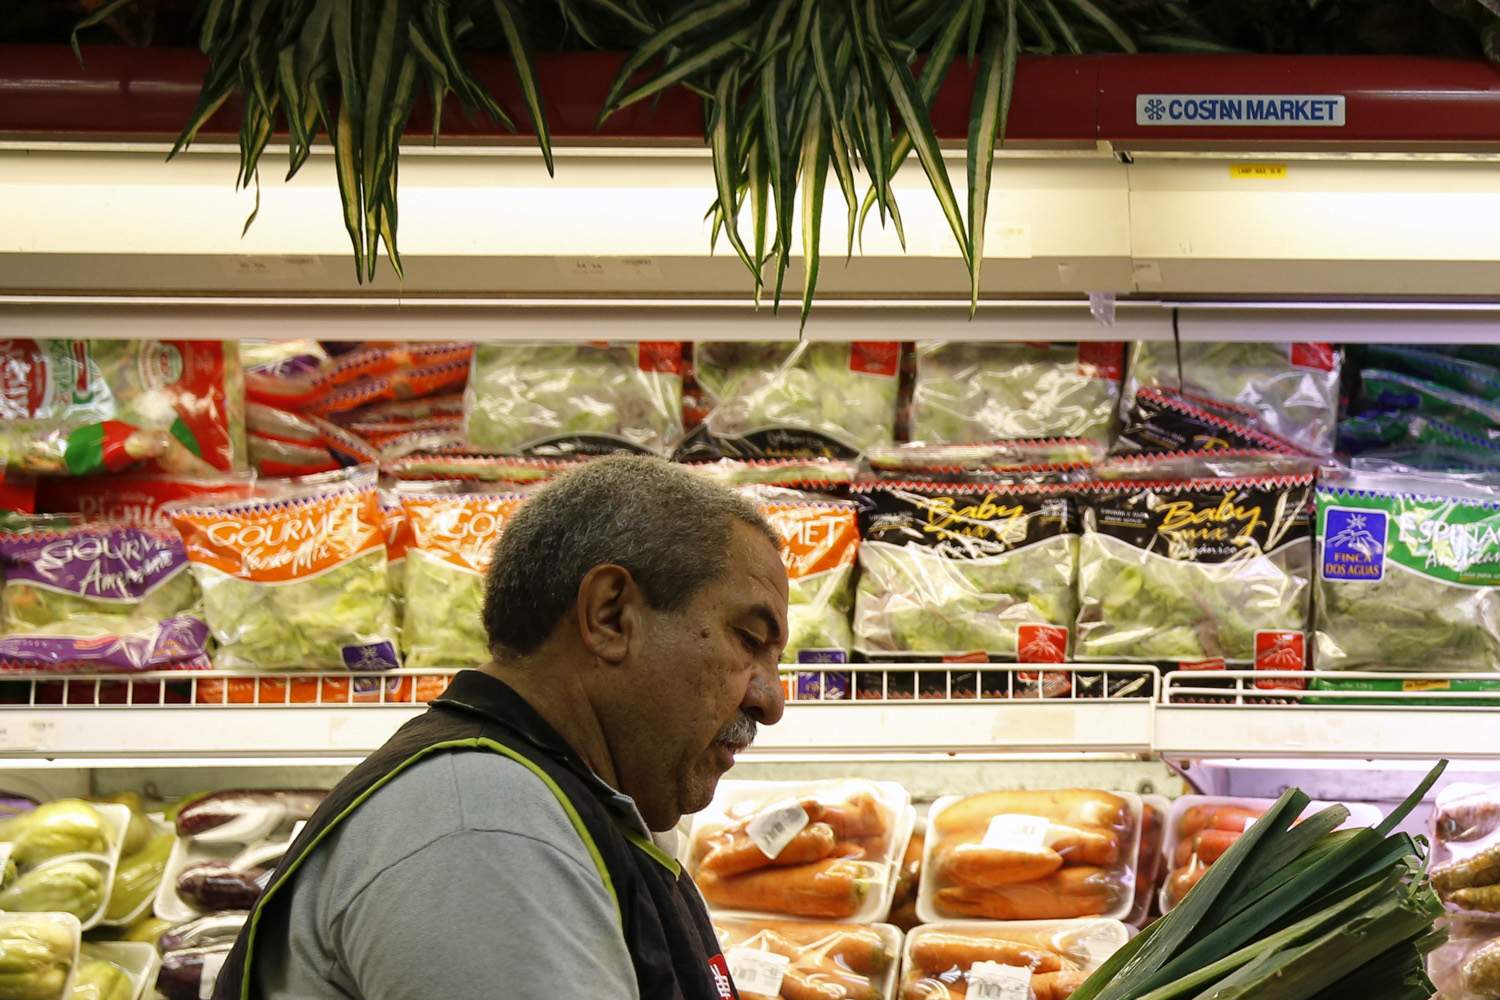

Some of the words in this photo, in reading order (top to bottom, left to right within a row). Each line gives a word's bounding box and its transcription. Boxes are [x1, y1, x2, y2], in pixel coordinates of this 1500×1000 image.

[1168, 99, 1243, 121] COSTAN
[1246, 99, 1338, 121] MARKET
[206, 501, 368, 548] GOURMET
[917, 493, 1024, 542] Baby
[1155, 490, 1264, 544] Baby
[1325, 564, 1346, 576] DOS
[1348, 564, 1380, 577] AGUAS
[1332, 552, 1373, 563] FINCA
